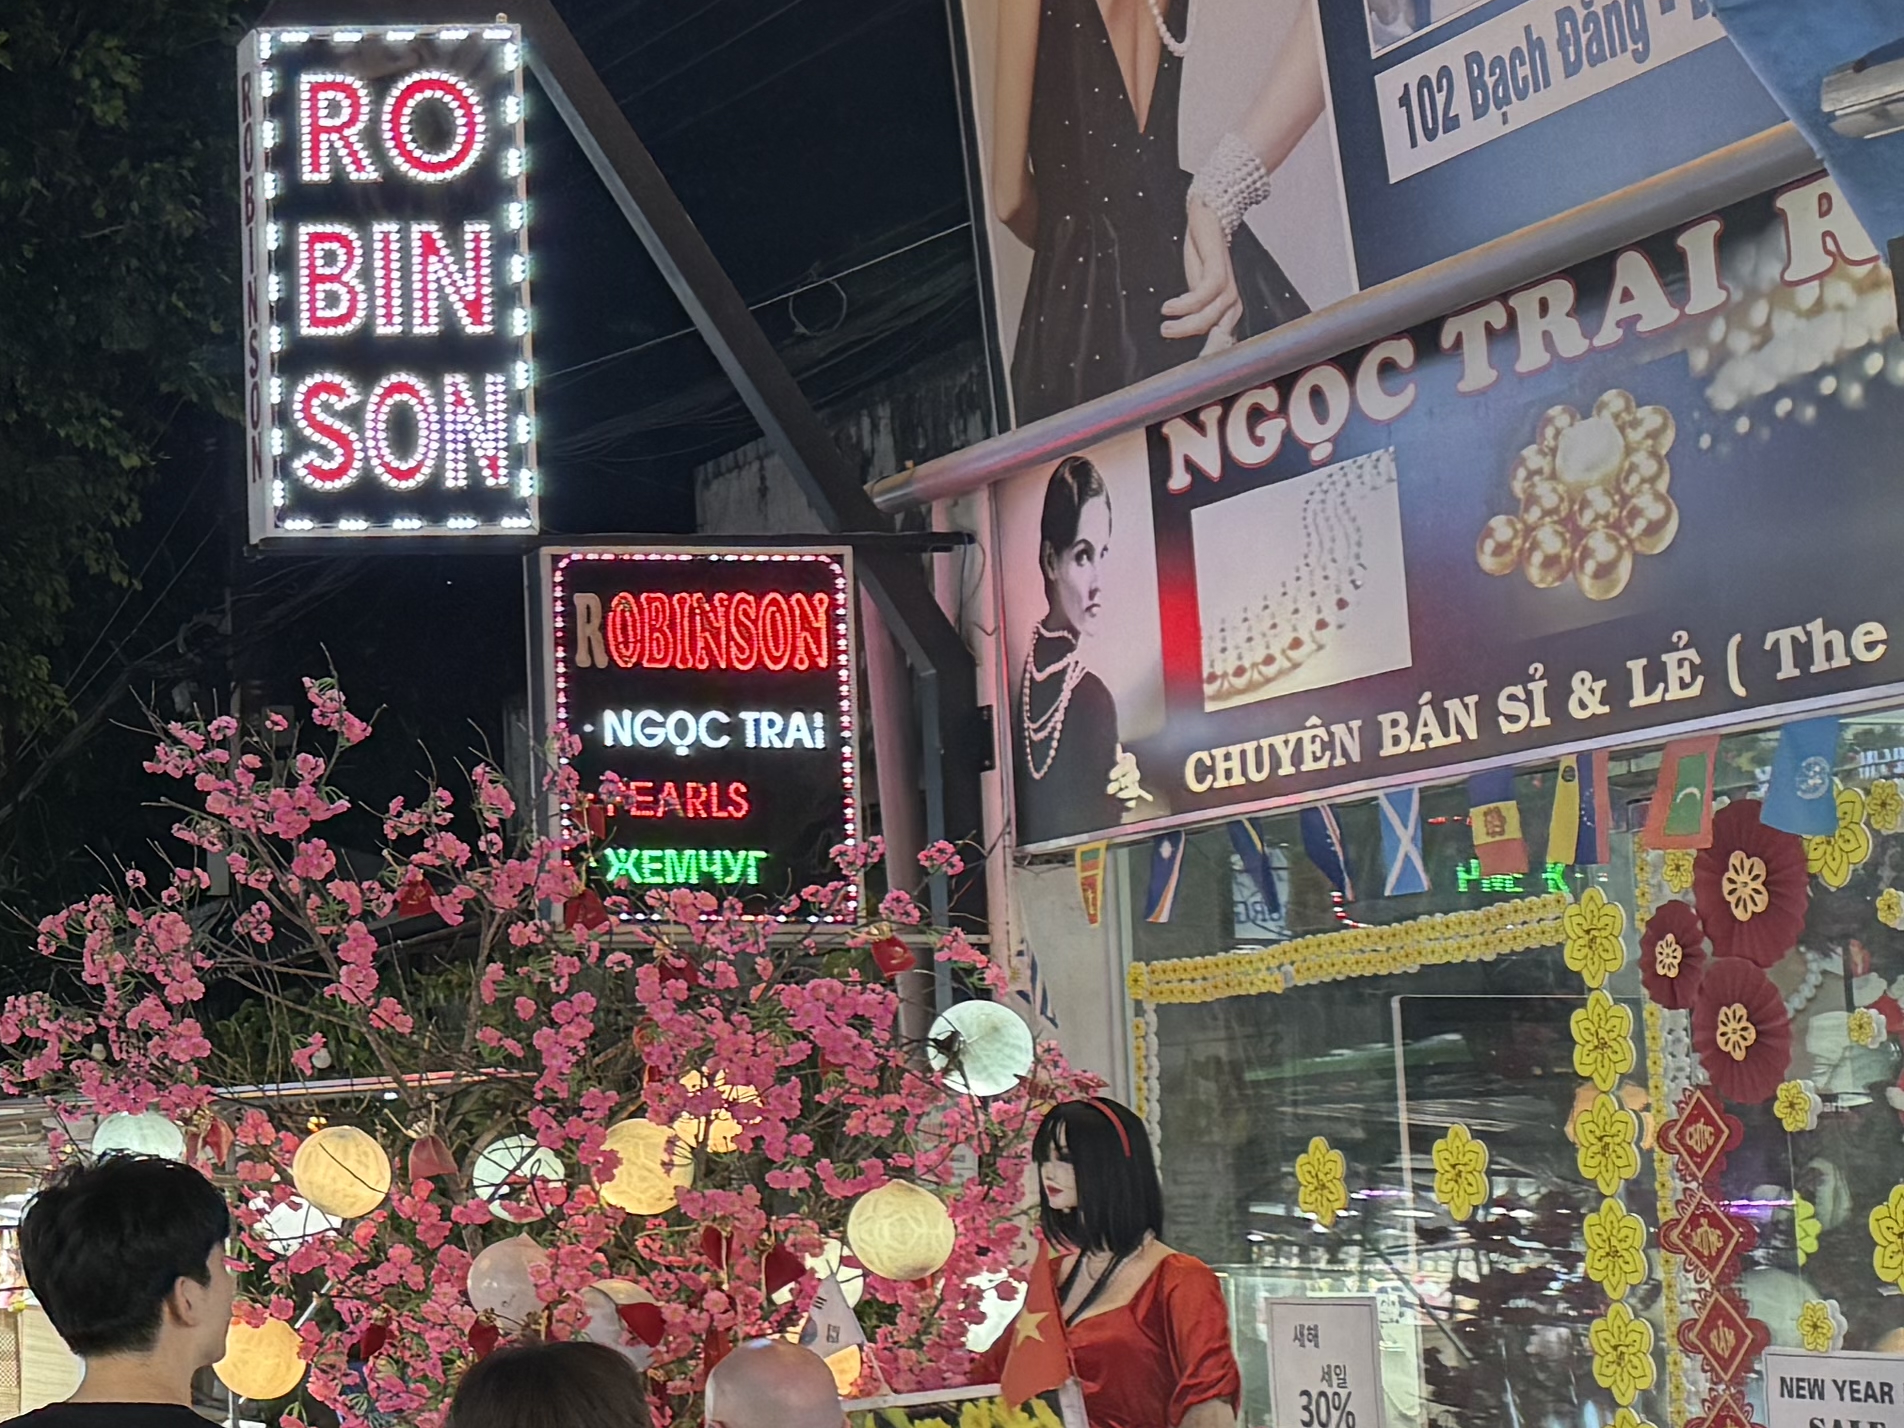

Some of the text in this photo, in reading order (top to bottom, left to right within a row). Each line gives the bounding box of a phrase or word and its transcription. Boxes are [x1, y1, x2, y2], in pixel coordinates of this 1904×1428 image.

[295, 69, 487, 185] RO
[1398, 65, 1461, 149] 102
[1464, 24, 1552, 126] Bạch
[238, 69, 265, 488] ROBINSON
[295, 221, 497, 338] BIN
[1160, 332, 1419, 495] NGỌC
[1439, 215, 1731, 400] TRAI
[291, 371, 510, 491] SON
[573, 590, 830, 673] ROBINSON
[603, 709, 826, 758] NGỌC TRAI
[1183, 715, 1366, 797] CHUYÊN
[1379, 682, 1482, 760] BÁN
[1496, 660, 1553, 733] SỈ
[1566, 667, 1611, 717] &
[1628, 631, 1705, 710] LẺ
[1764, 608, 1890, 682] The
[604, 847, 769, 885] ЖЕМЧУГ
[1779, 1374, 1895, 1405] NEW YEAR
